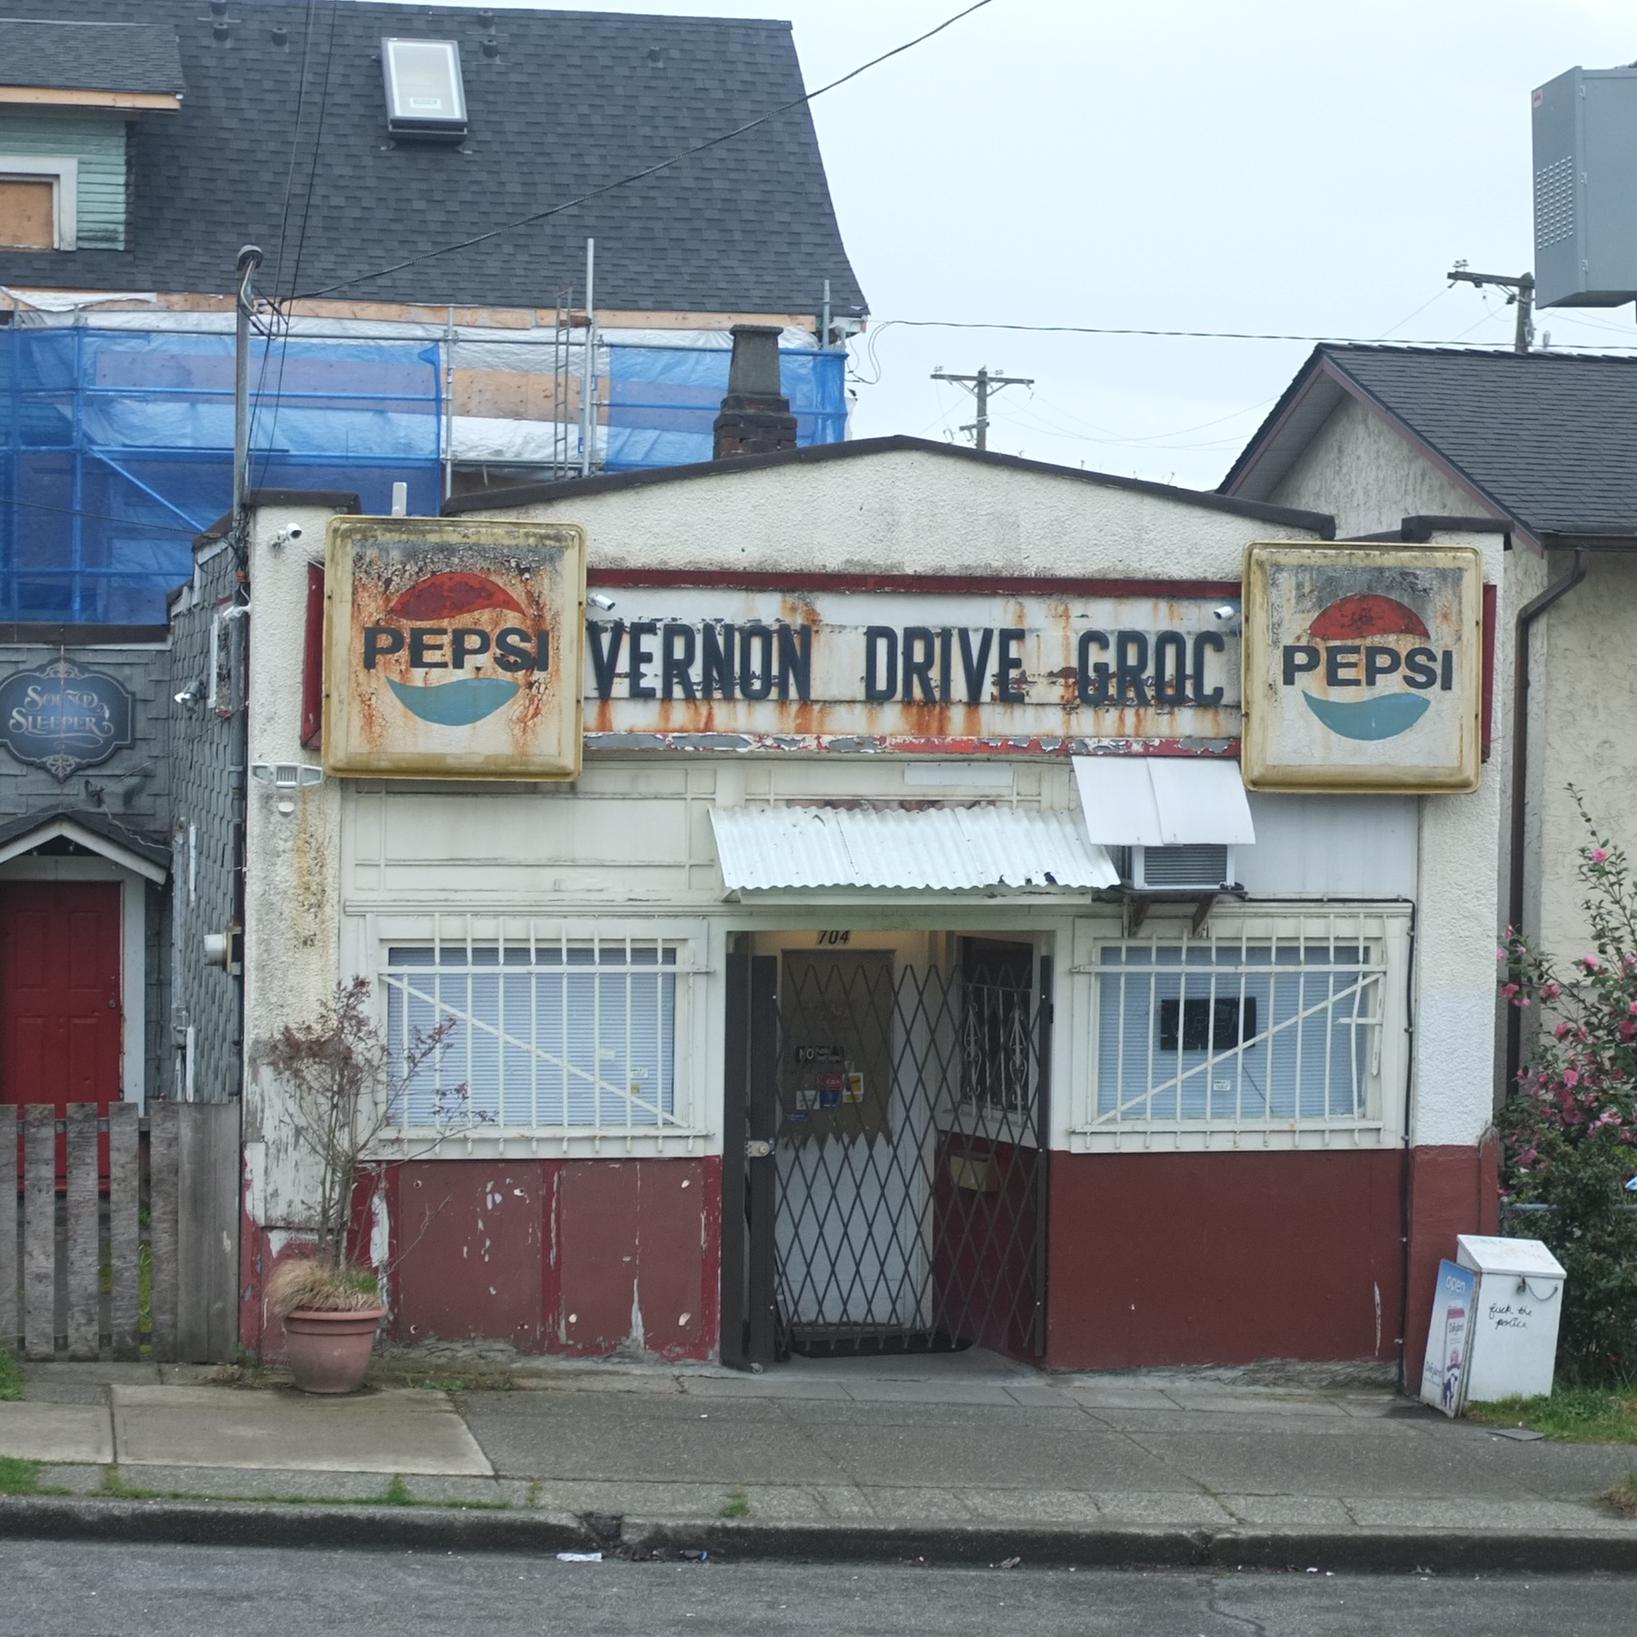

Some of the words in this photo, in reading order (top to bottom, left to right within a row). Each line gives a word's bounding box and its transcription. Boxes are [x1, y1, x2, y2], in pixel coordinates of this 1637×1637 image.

[363, 626, 549, 673] PEPSI
[585, 619, 811, 700] VERNON
[865, 626, 1025, 704] DRIVE
[1078, 630, 1224, 705] GROC
[1282, 645, 1453, 691] PEPSI
[9, 706, 114, 737] SLEEPER
[817, 929, 850, 945] 704
